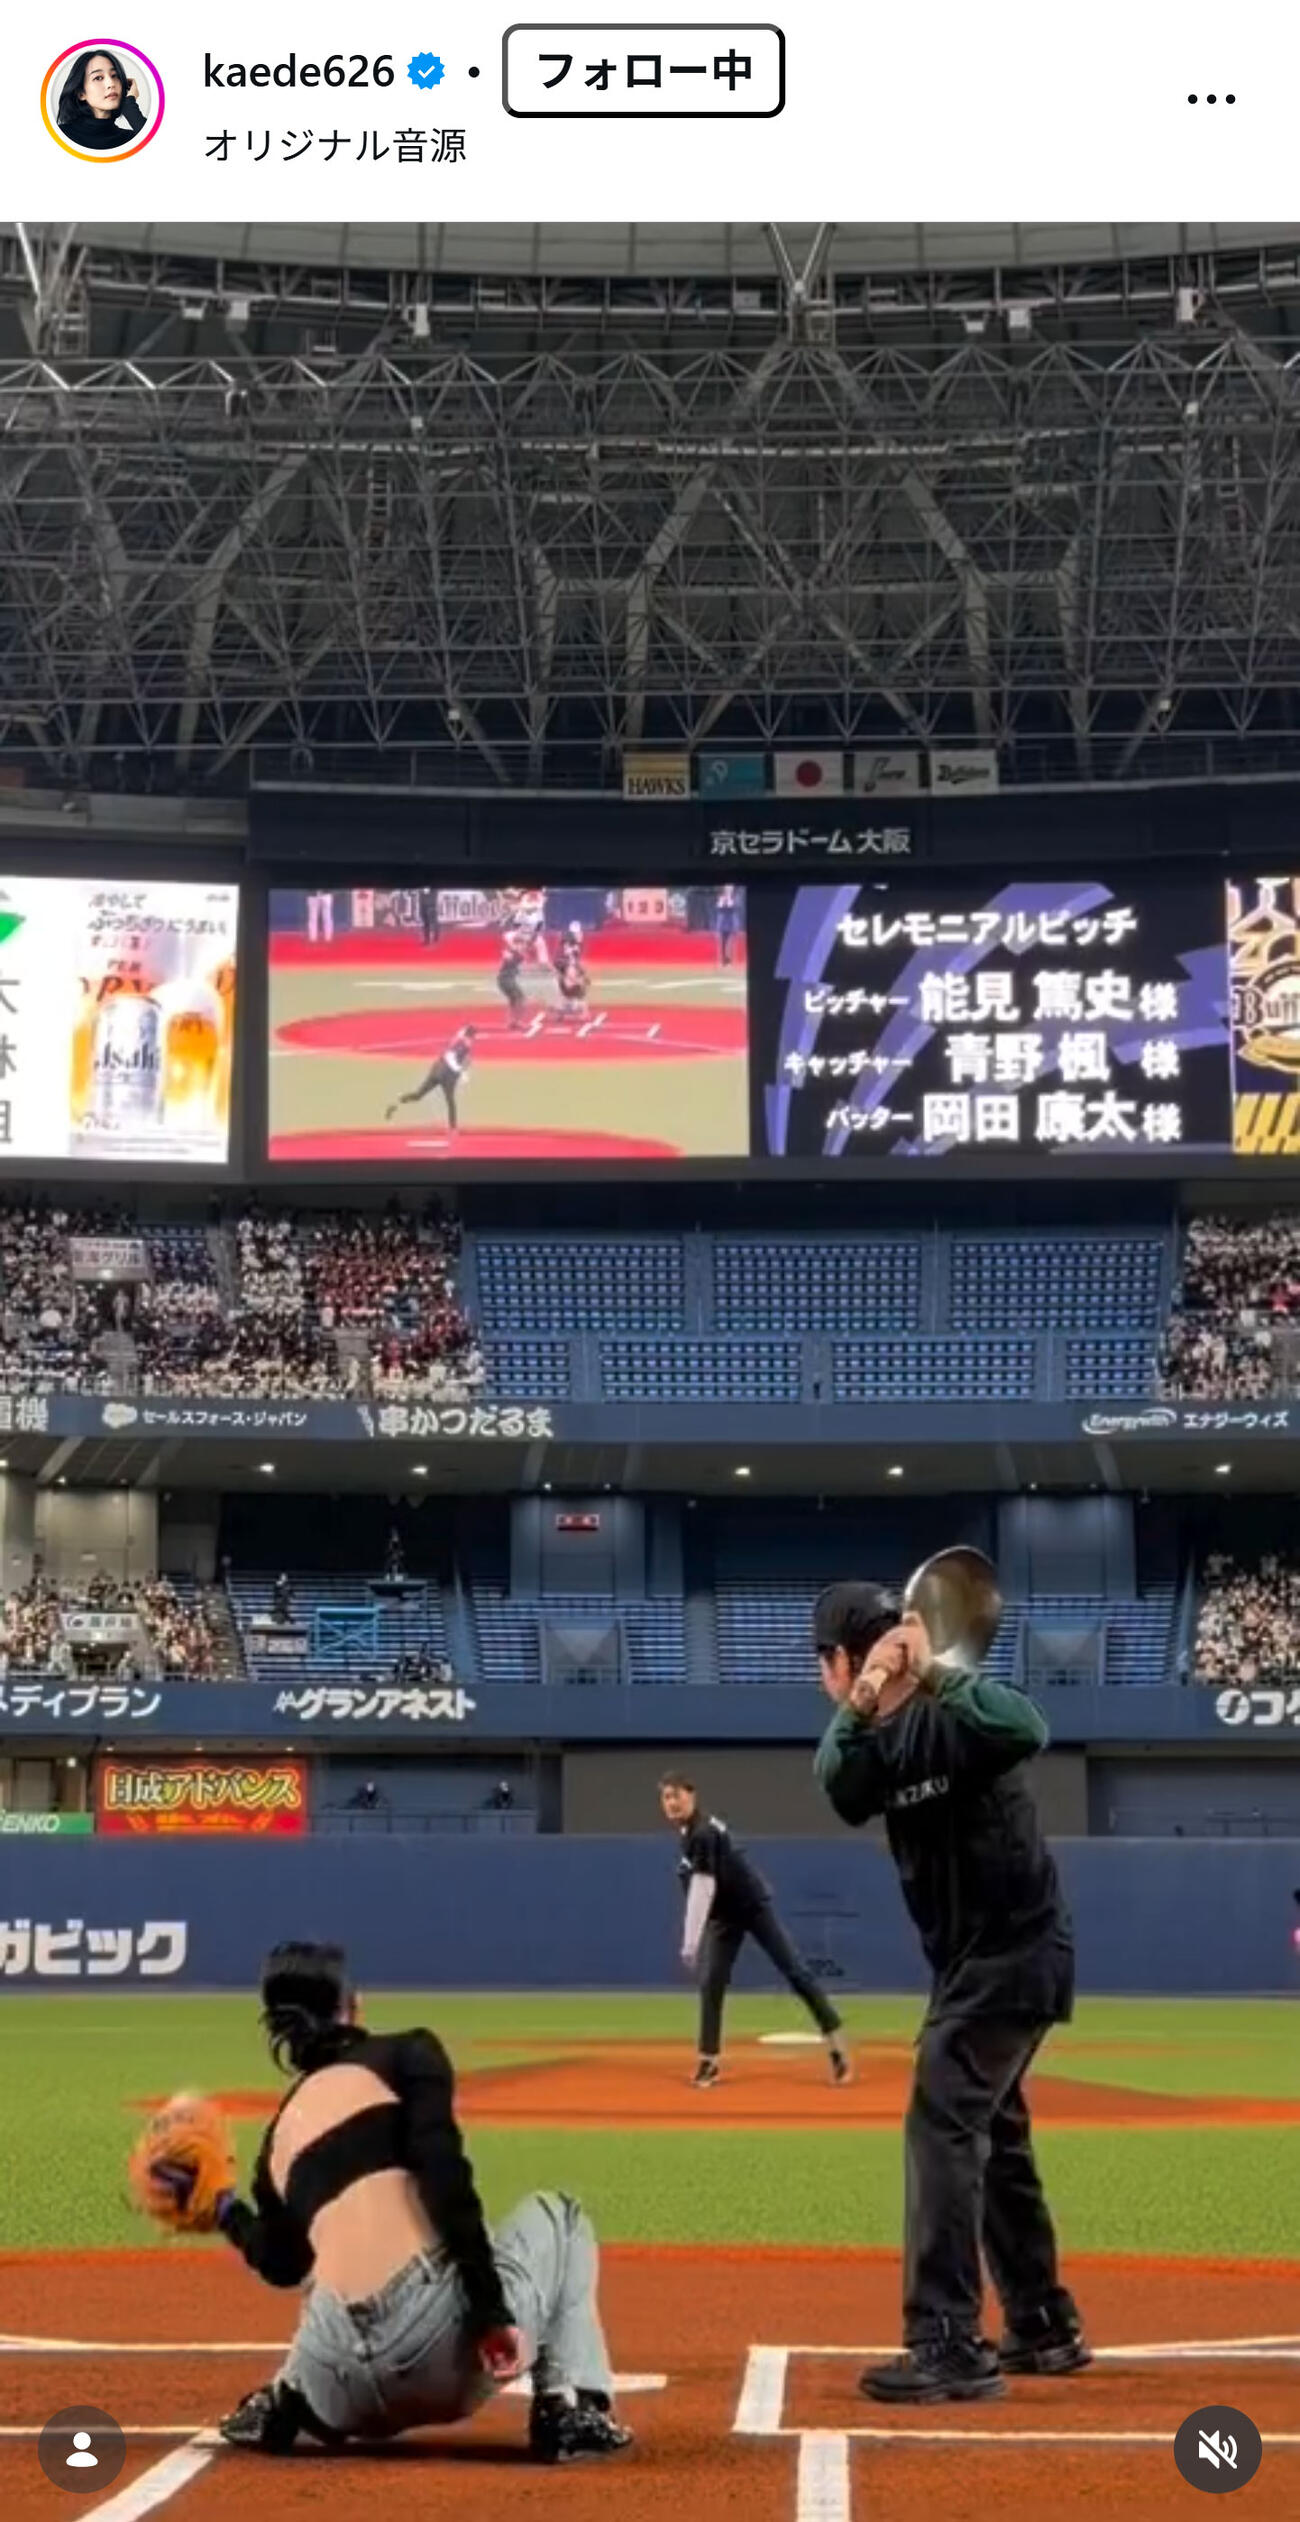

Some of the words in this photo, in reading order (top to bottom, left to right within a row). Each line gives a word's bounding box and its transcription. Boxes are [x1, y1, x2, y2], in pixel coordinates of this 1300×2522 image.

[627, 777, 686, 796] HAWKS
[836, 907, 1138, 947] セレモニアルピッチ
[804, 988, 910, 1015] ピッチャー
[918, 971, 1021, 1023] 能見
[784, 1050, 912, 1077] キャッチャー
[944, 1032, 1044, 1083] 青野
[1057, 1031, 1111, 1082] 楓
[1140, 1040, 1181, 1079] 様
[825, 1105, 913, 1131] バッター
[923, 1093, 1020, 1142] 岡田
[142, 1408, 308, 1428] セールスフォース・ジャパン
[378, 1404, 555, 1438] 串かつだるま
[1183, 1409, 1291, 1430] エナジーウィズ
[296, 1687, 477, 1720] グランアネスト
